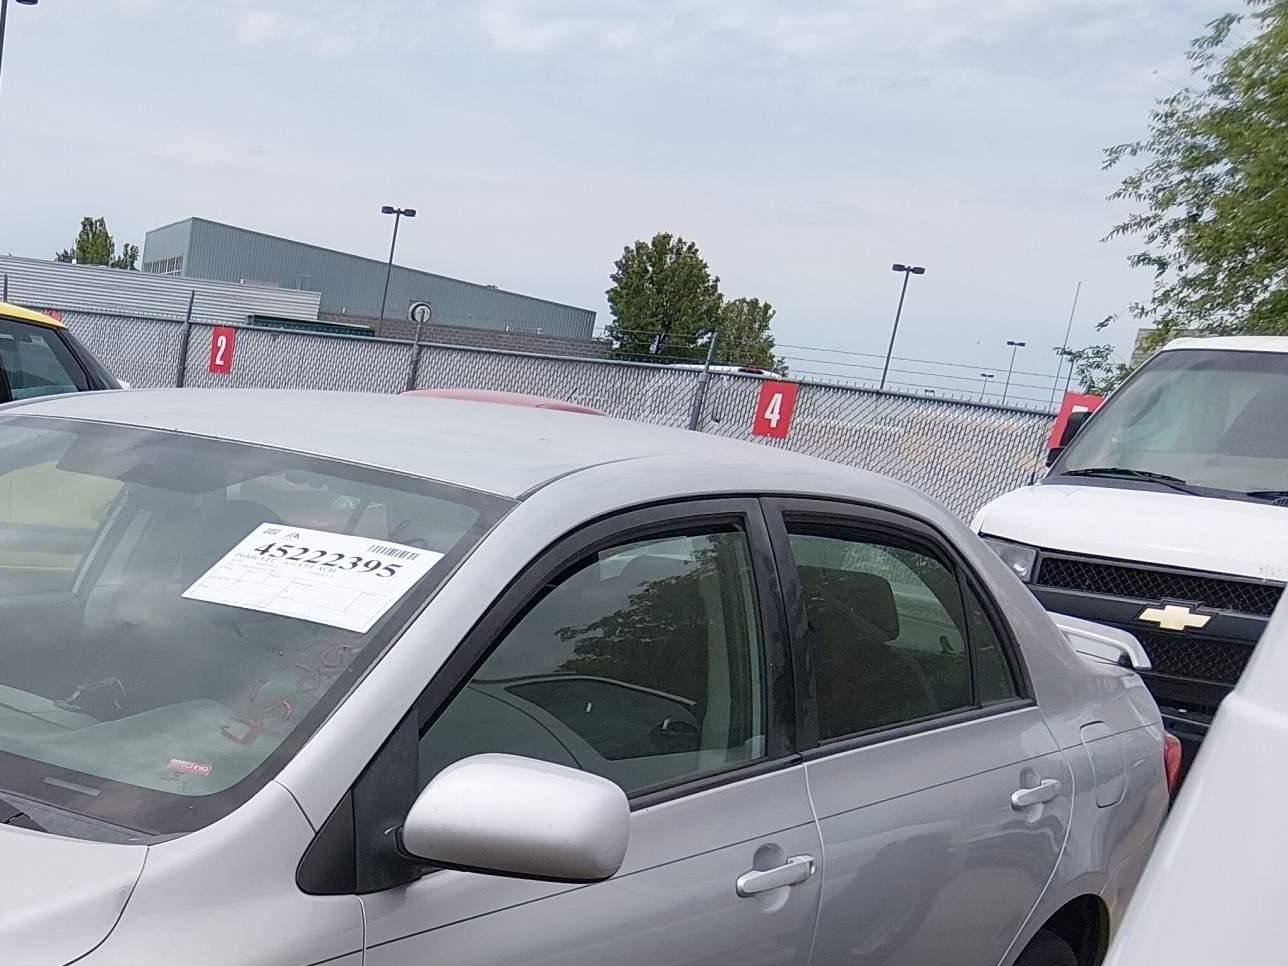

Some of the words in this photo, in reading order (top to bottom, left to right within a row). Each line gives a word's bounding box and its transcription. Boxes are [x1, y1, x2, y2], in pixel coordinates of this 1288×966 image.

[215, 335, 227, 366] 2
[764, 392, 783, 428] 4
[254, 542, 404, 578] 45222395
